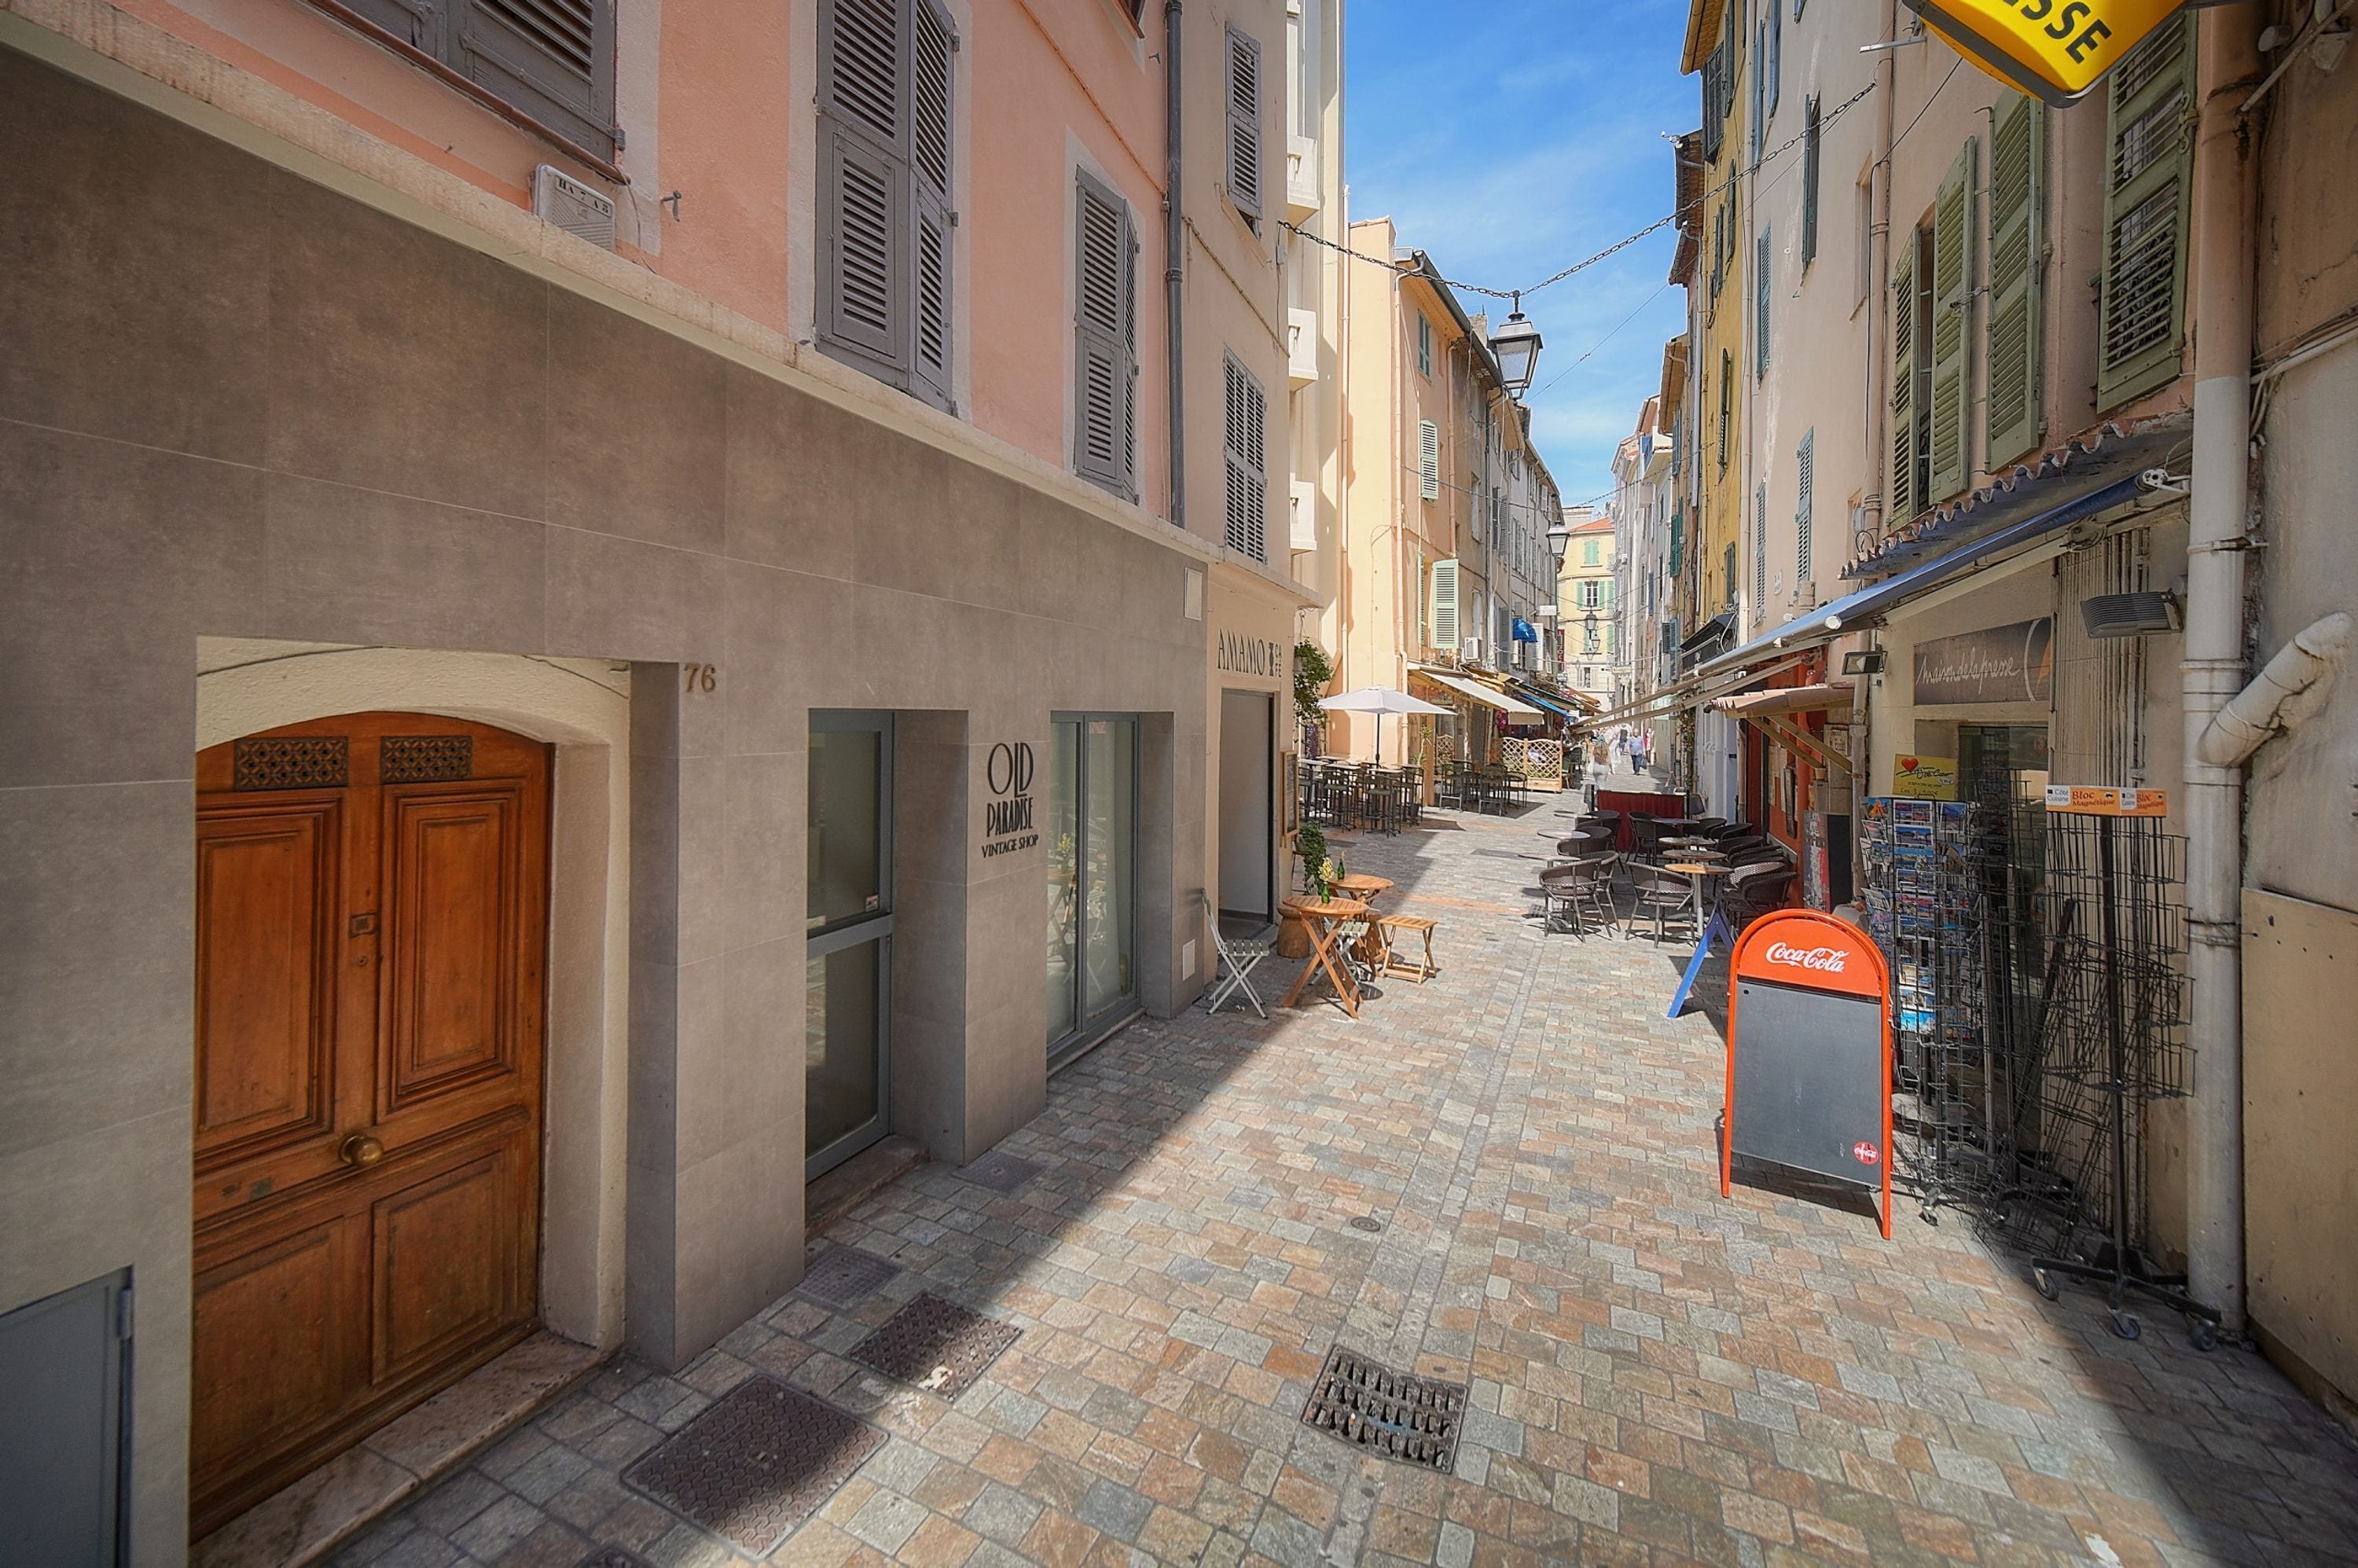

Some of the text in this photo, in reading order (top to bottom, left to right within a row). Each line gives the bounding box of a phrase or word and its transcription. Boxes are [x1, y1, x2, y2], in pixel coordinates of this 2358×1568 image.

[2002, 0, 2113, 64] SSE
[684, 663, 716, 692] 76
[987, 742, 1034, 798] OLD
[2072, 791, 2095, 799] Bloc
[986, 797, 1034, 837] PARADISE
[981, 834, 1039, 858] VINTAGE SHOP
[1765, 942, 1850, 973] Coca-Cola
